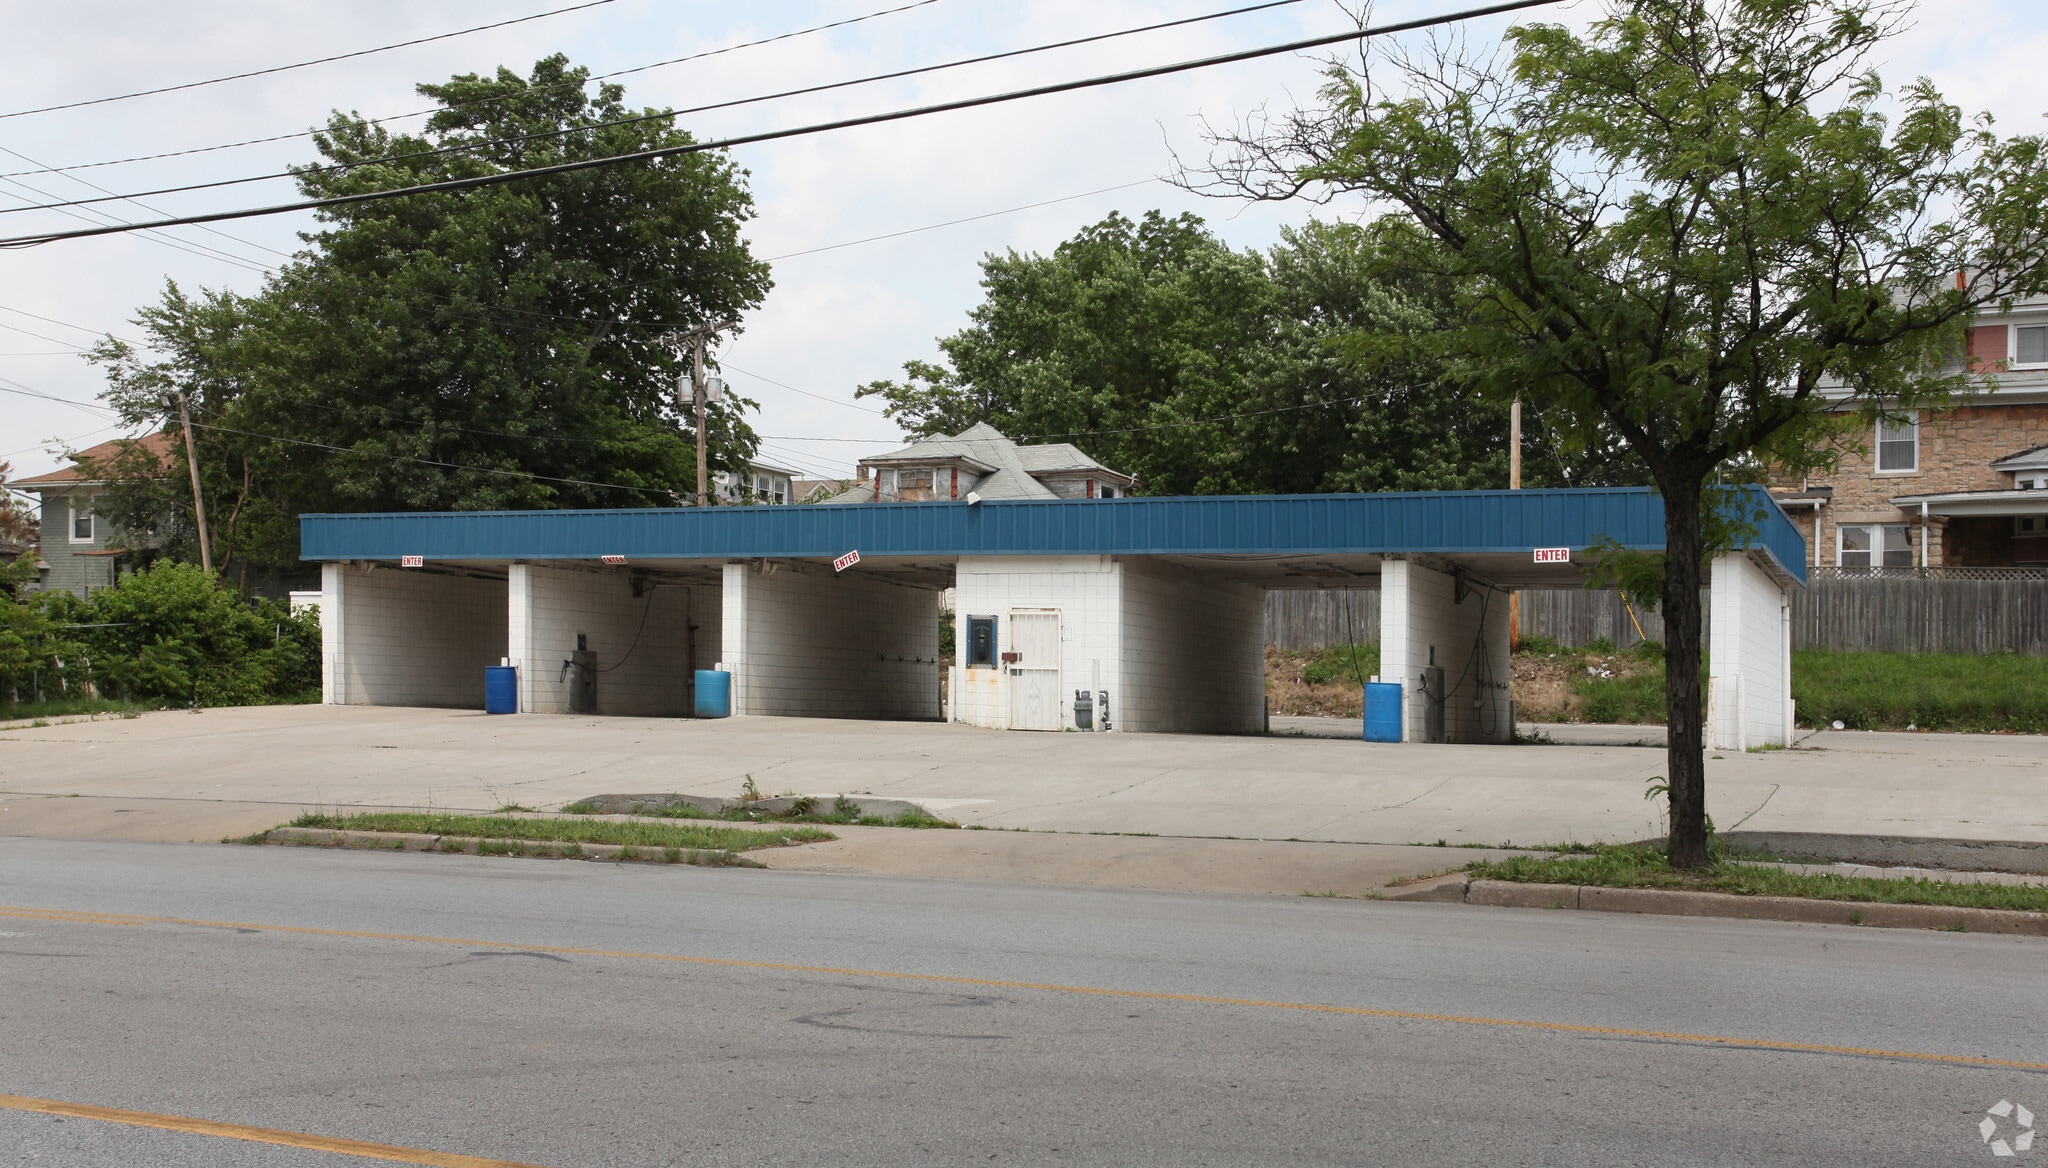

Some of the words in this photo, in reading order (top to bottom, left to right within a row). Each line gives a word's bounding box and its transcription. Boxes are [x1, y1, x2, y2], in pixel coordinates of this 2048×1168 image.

[835, 552, 858, 569] ENTER
[1536, 550, 1567, 561] ENTER
[404, 557, 421, 566] ENTER
